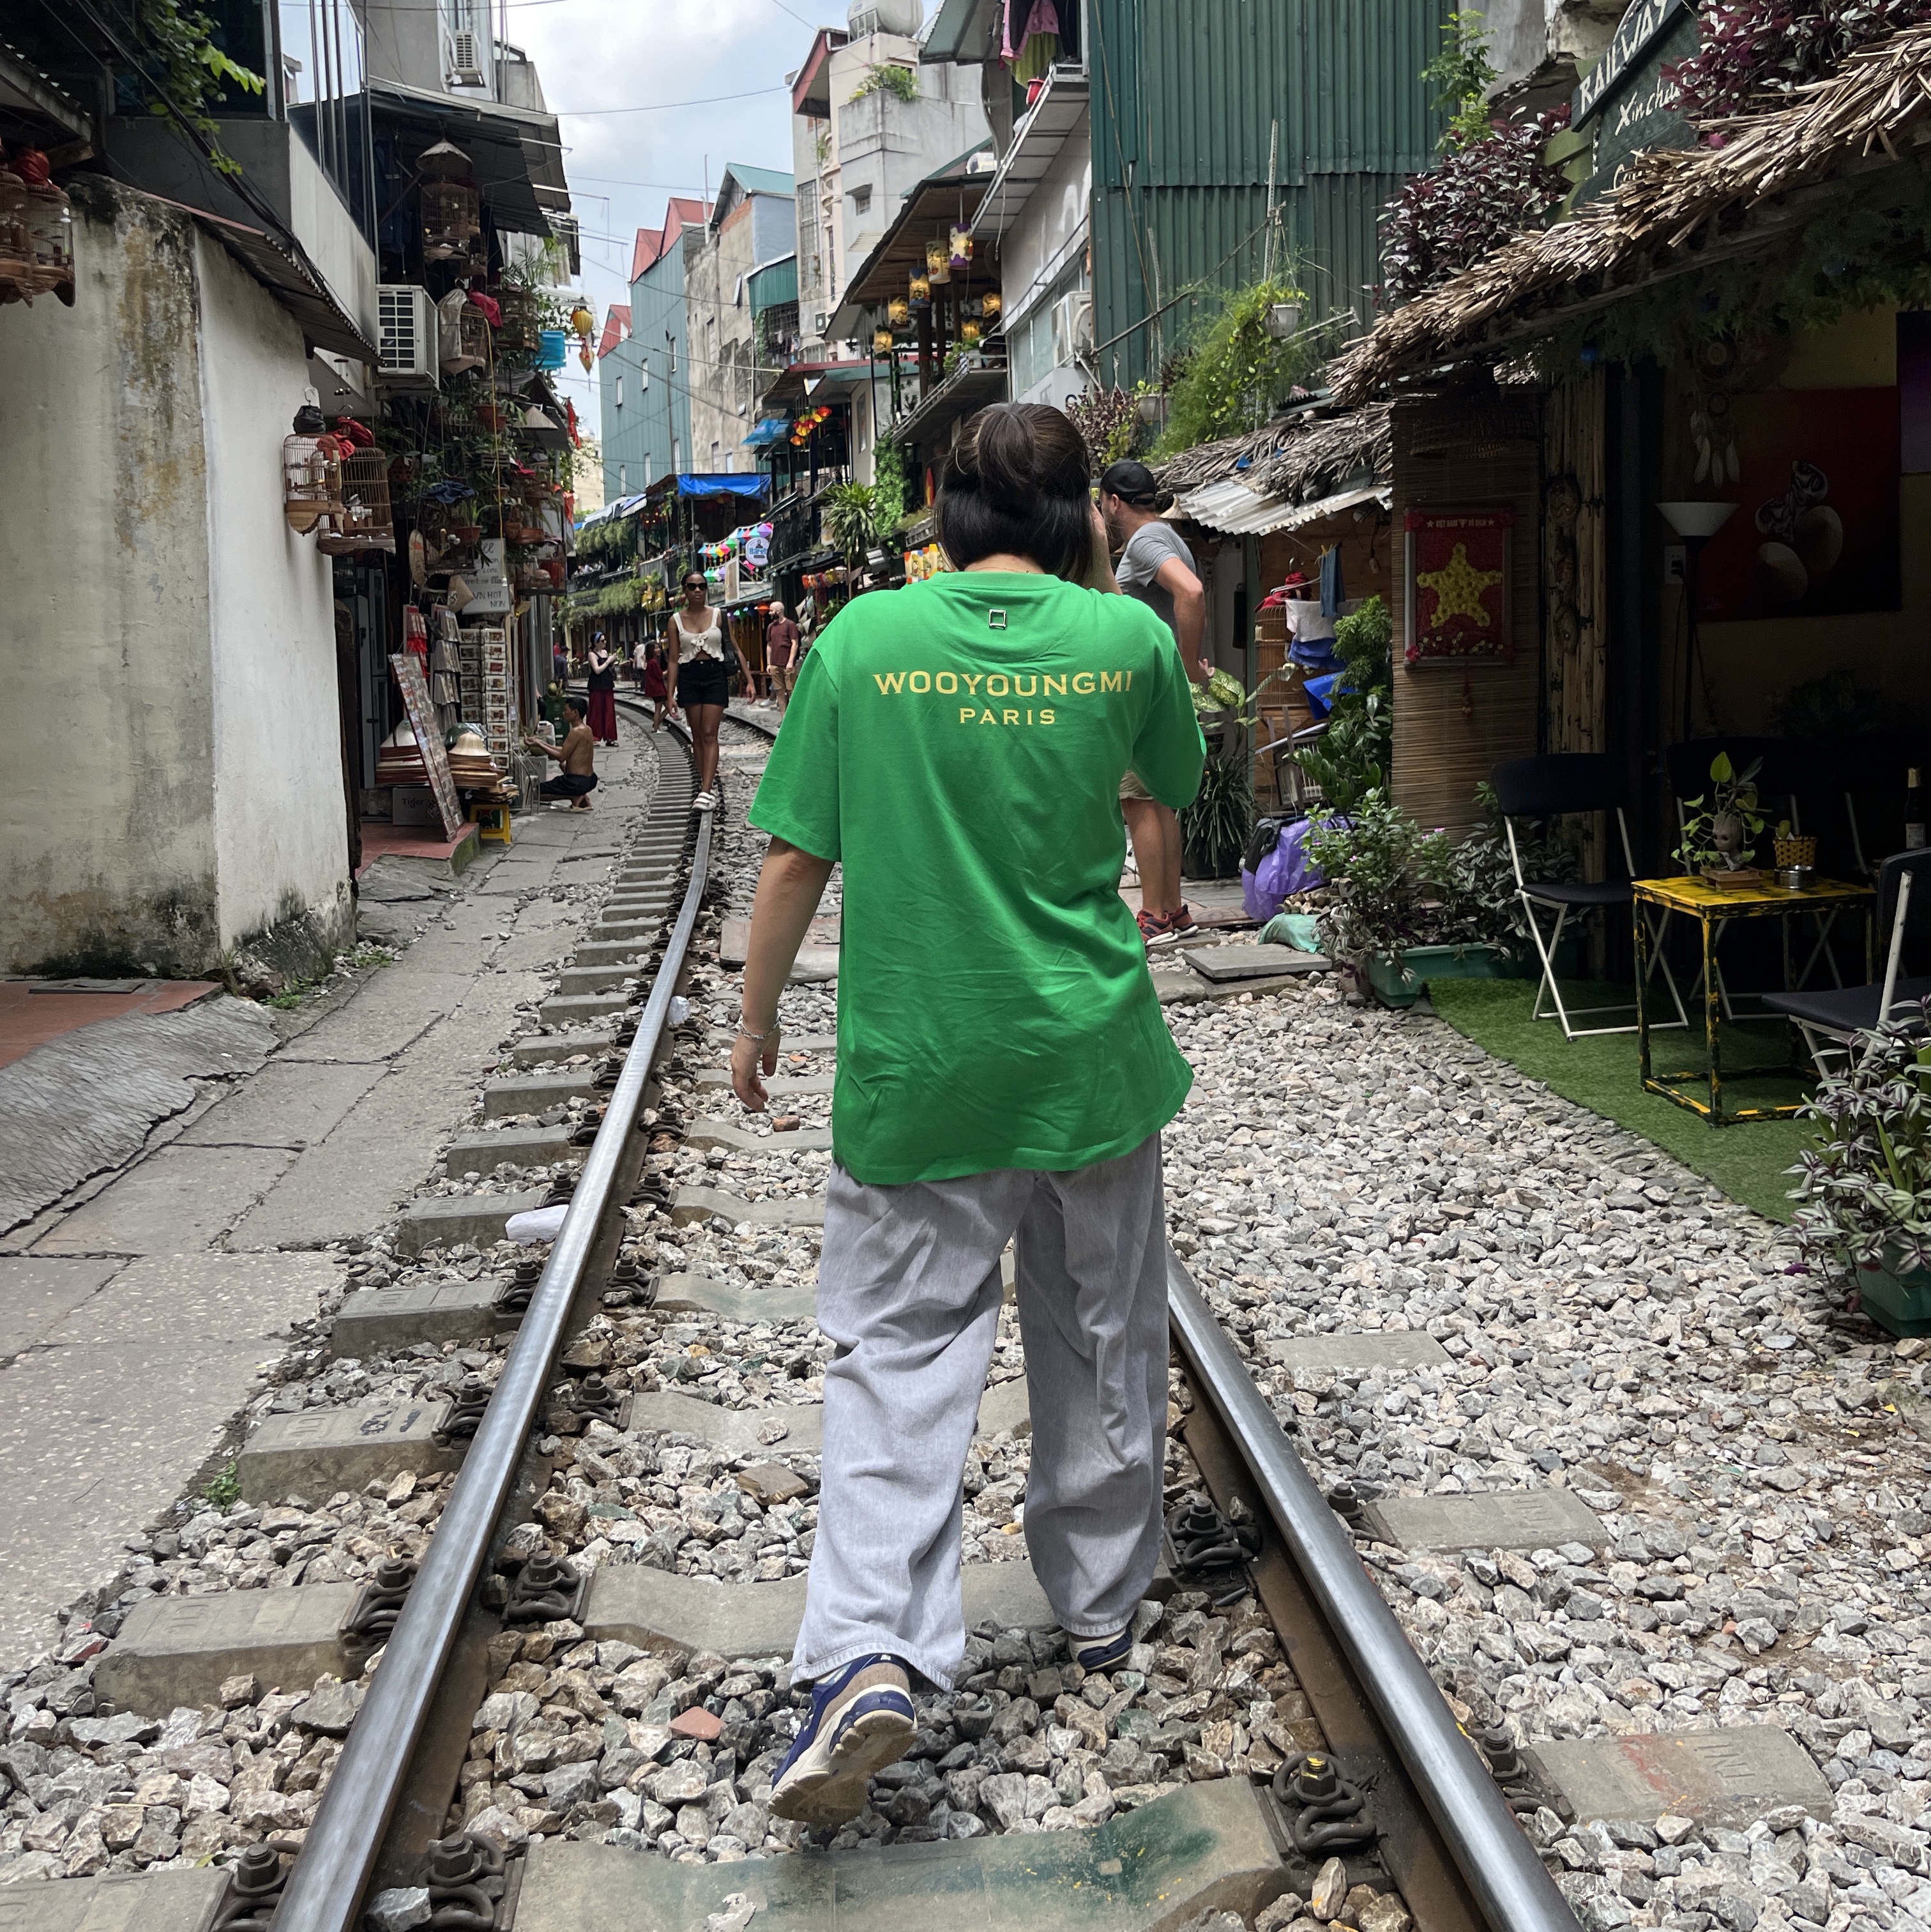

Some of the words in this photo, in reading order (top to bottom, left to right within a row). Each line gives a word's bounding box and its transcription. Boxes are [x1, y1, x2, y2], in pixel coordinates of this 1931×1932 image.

[1579, 0, 1669, 115] RAILWAY
[873, 670, 1133, 697] WOOYOUNGMI
[959, 708, 1056, 725] PARIS
[402, 797, 425, 808] Tiger
